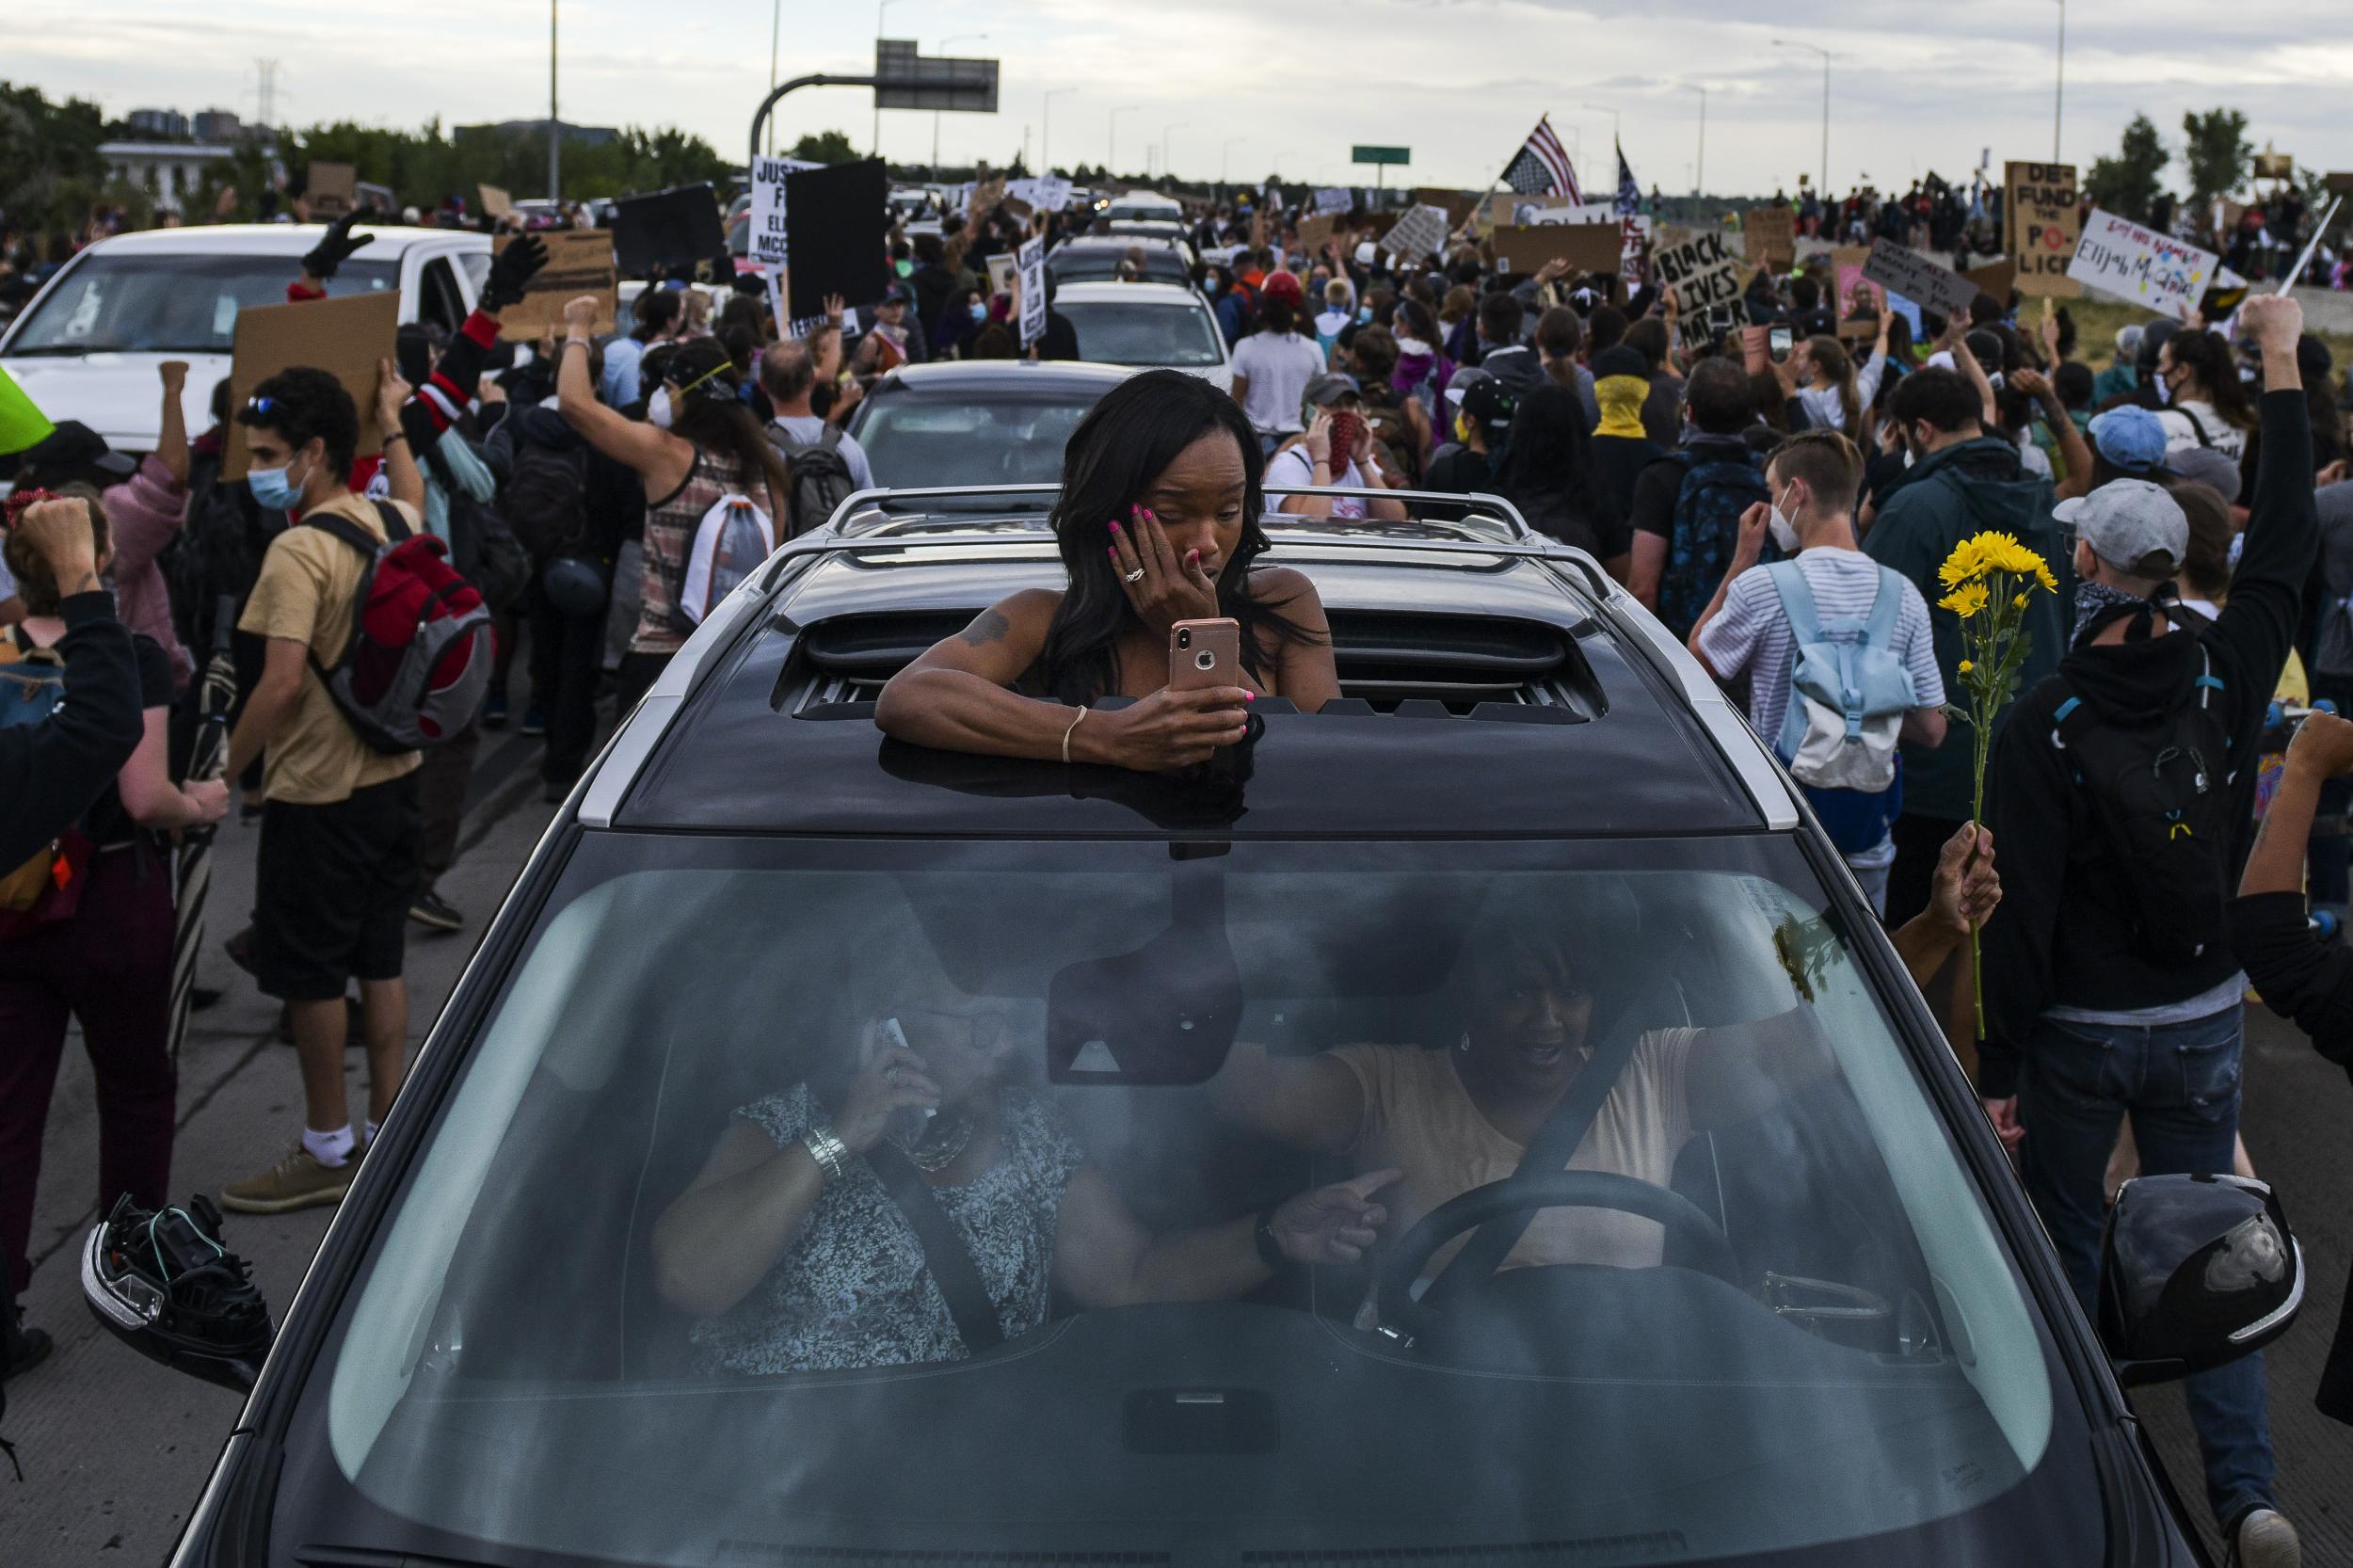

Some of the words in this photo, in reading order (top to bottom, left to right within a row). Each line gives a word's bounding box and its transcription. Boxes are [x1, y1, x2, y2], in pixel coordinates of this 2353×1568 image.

[2029, 163, 2074, 184] DE-
[2017, 184, 2075, 207] FUND
[2034, 208, 2058, 221] THE
[2028, 224, 2073, 251] PO-
[1658, 233, 1728, 282] BLACK
[2076, 237, 2129, 276] Elijah
[1672, 265, 1739, 316] LIVES
[1679, 298, 1748, 350] MATR
